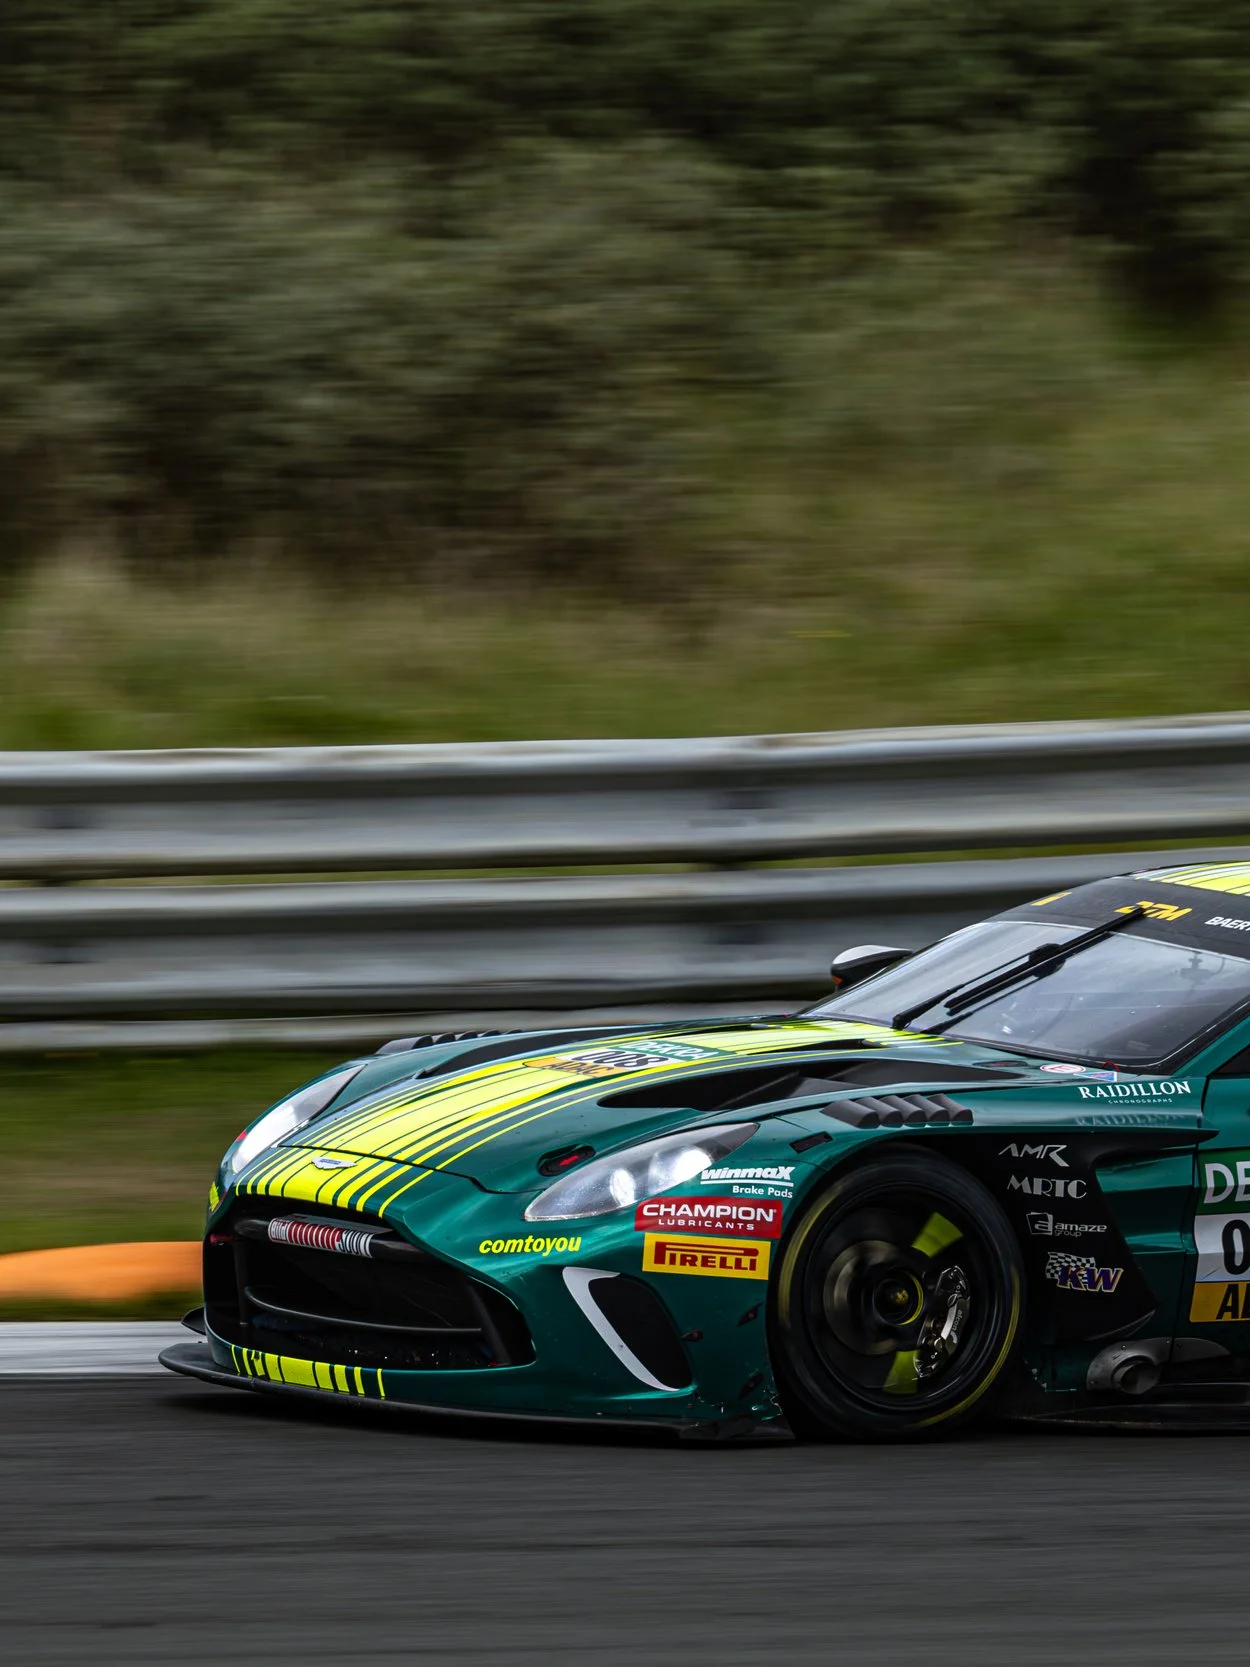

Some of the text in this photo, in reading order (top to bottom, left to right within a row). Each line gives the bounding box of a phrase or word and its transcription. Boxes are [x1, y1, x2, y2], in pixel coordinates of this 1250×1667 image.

[571, 1050, 669, 1068] 008
[619, 1041, 720, 1060] DEKRA
[1077, 1080, 1192, 1099] RAIDILLON
[1108, 1097, 1173, 1105] CHRONOGRAPHS
[998, 1143, 1070, 1168] AMR
[732, 1185, 793, 1199] Brake Pads
[1006, 1174, 1088, 1199] MRTC
[642, 1203, 774, 1223] CHAMPION
[658, 1219, 755, 1231] LUBRICANTS
[1055, 1222, 1108, 1233] amaze
[1055, 1229, 1082, 1238] group
[479, 1235, 582, 1257] comtoyou
[653, 1241, 760, 1272] PIRELLI
[1056, 1265, 1125, 1293] KW
